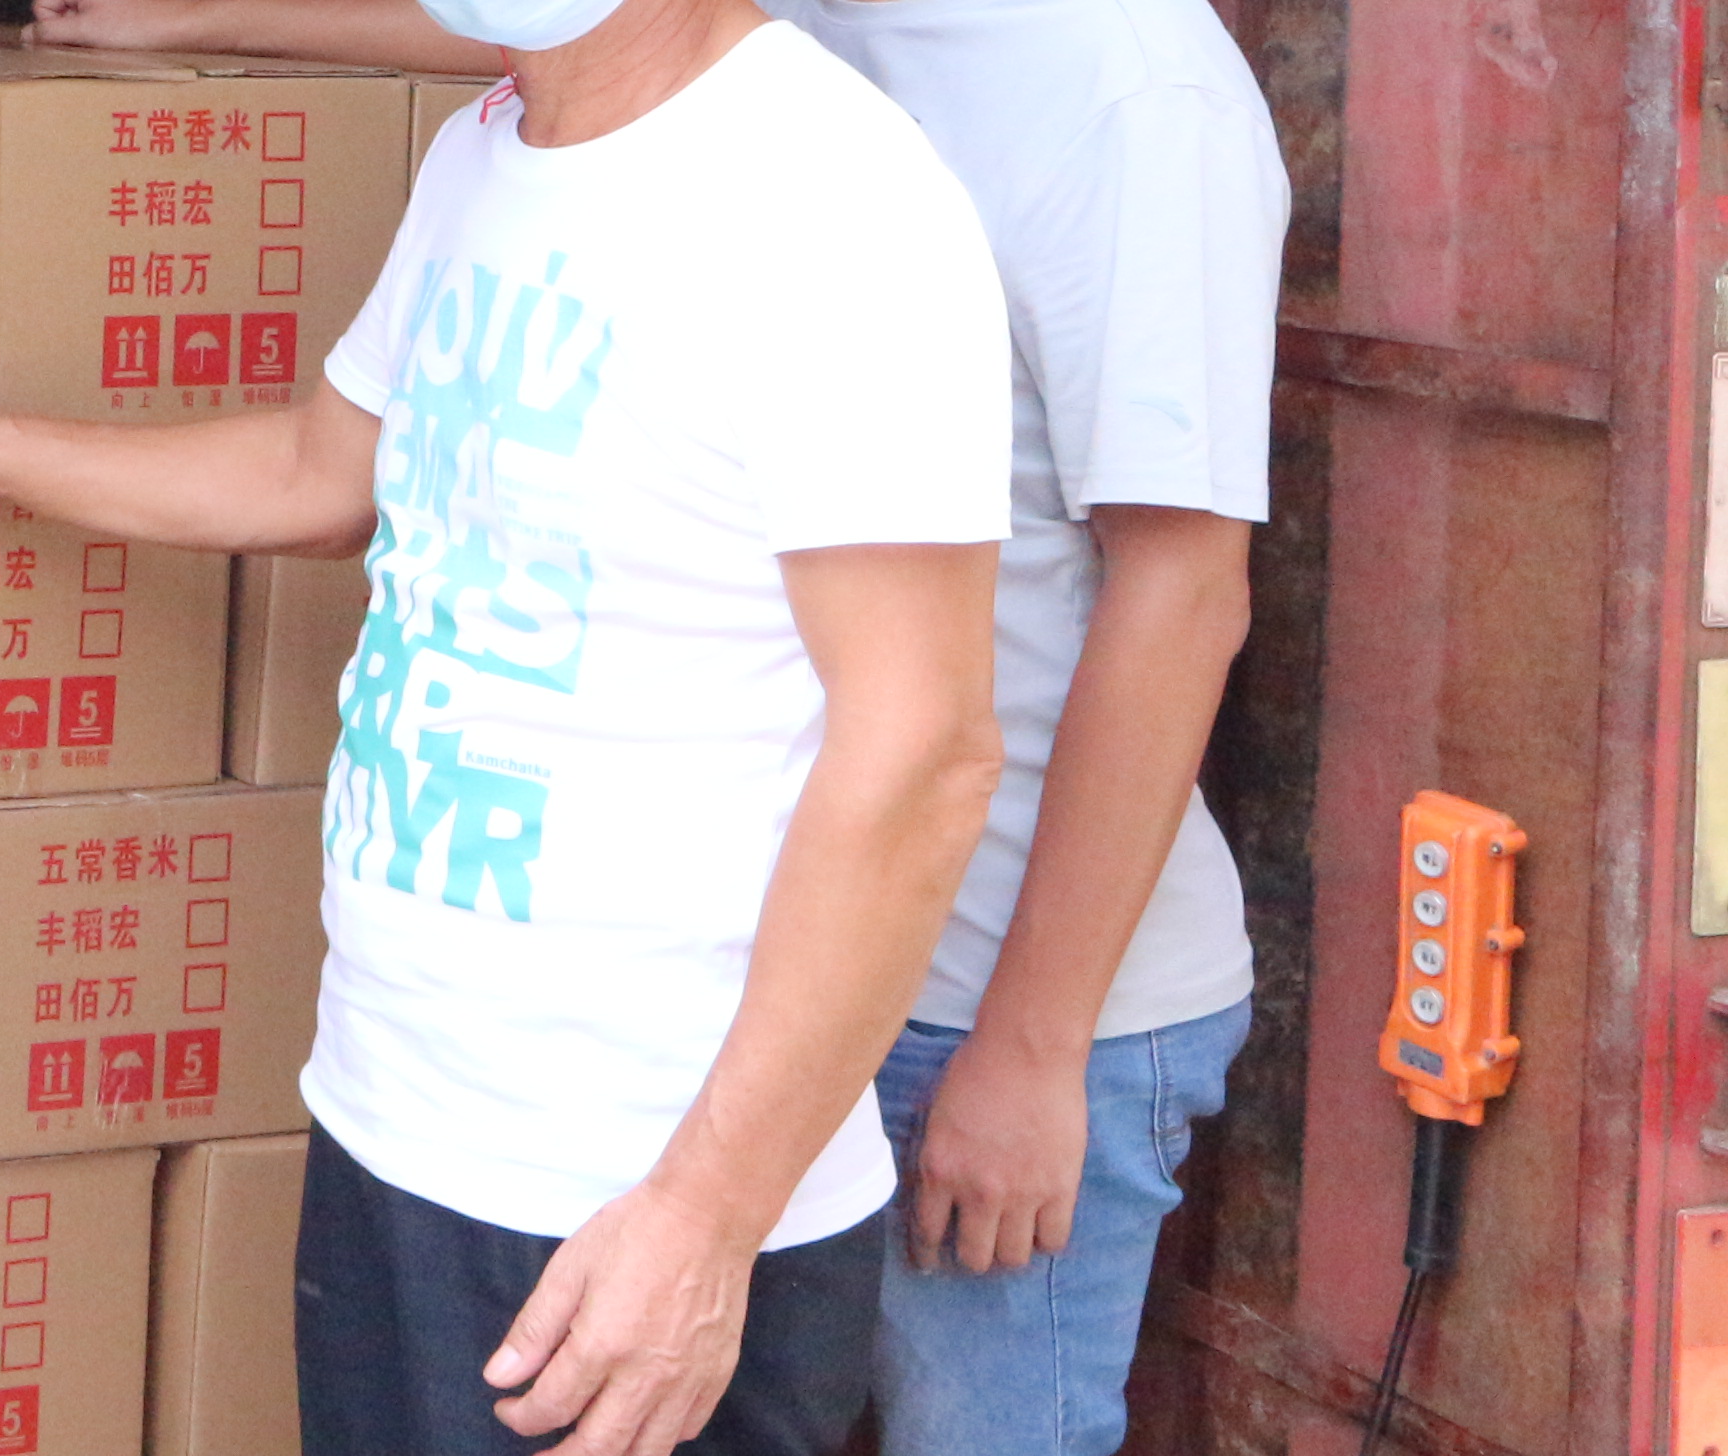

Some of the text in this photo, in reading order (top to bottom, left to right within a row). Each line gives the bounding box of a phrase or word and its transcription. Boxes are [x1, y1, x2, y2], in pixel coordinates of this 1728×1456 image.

[109, 109, 252, 156] 五常香米
[108, 179, 214, 227] 丰稻宏
[107, 252, 212, 298] 田佰万
[465, 750, 551, 779] Kamchatka
[38, 835, 179, 886] 五常香米
[36, 904, 141, 956] 丰稻宏
[34, 976, 139, 1024] 田佰万
